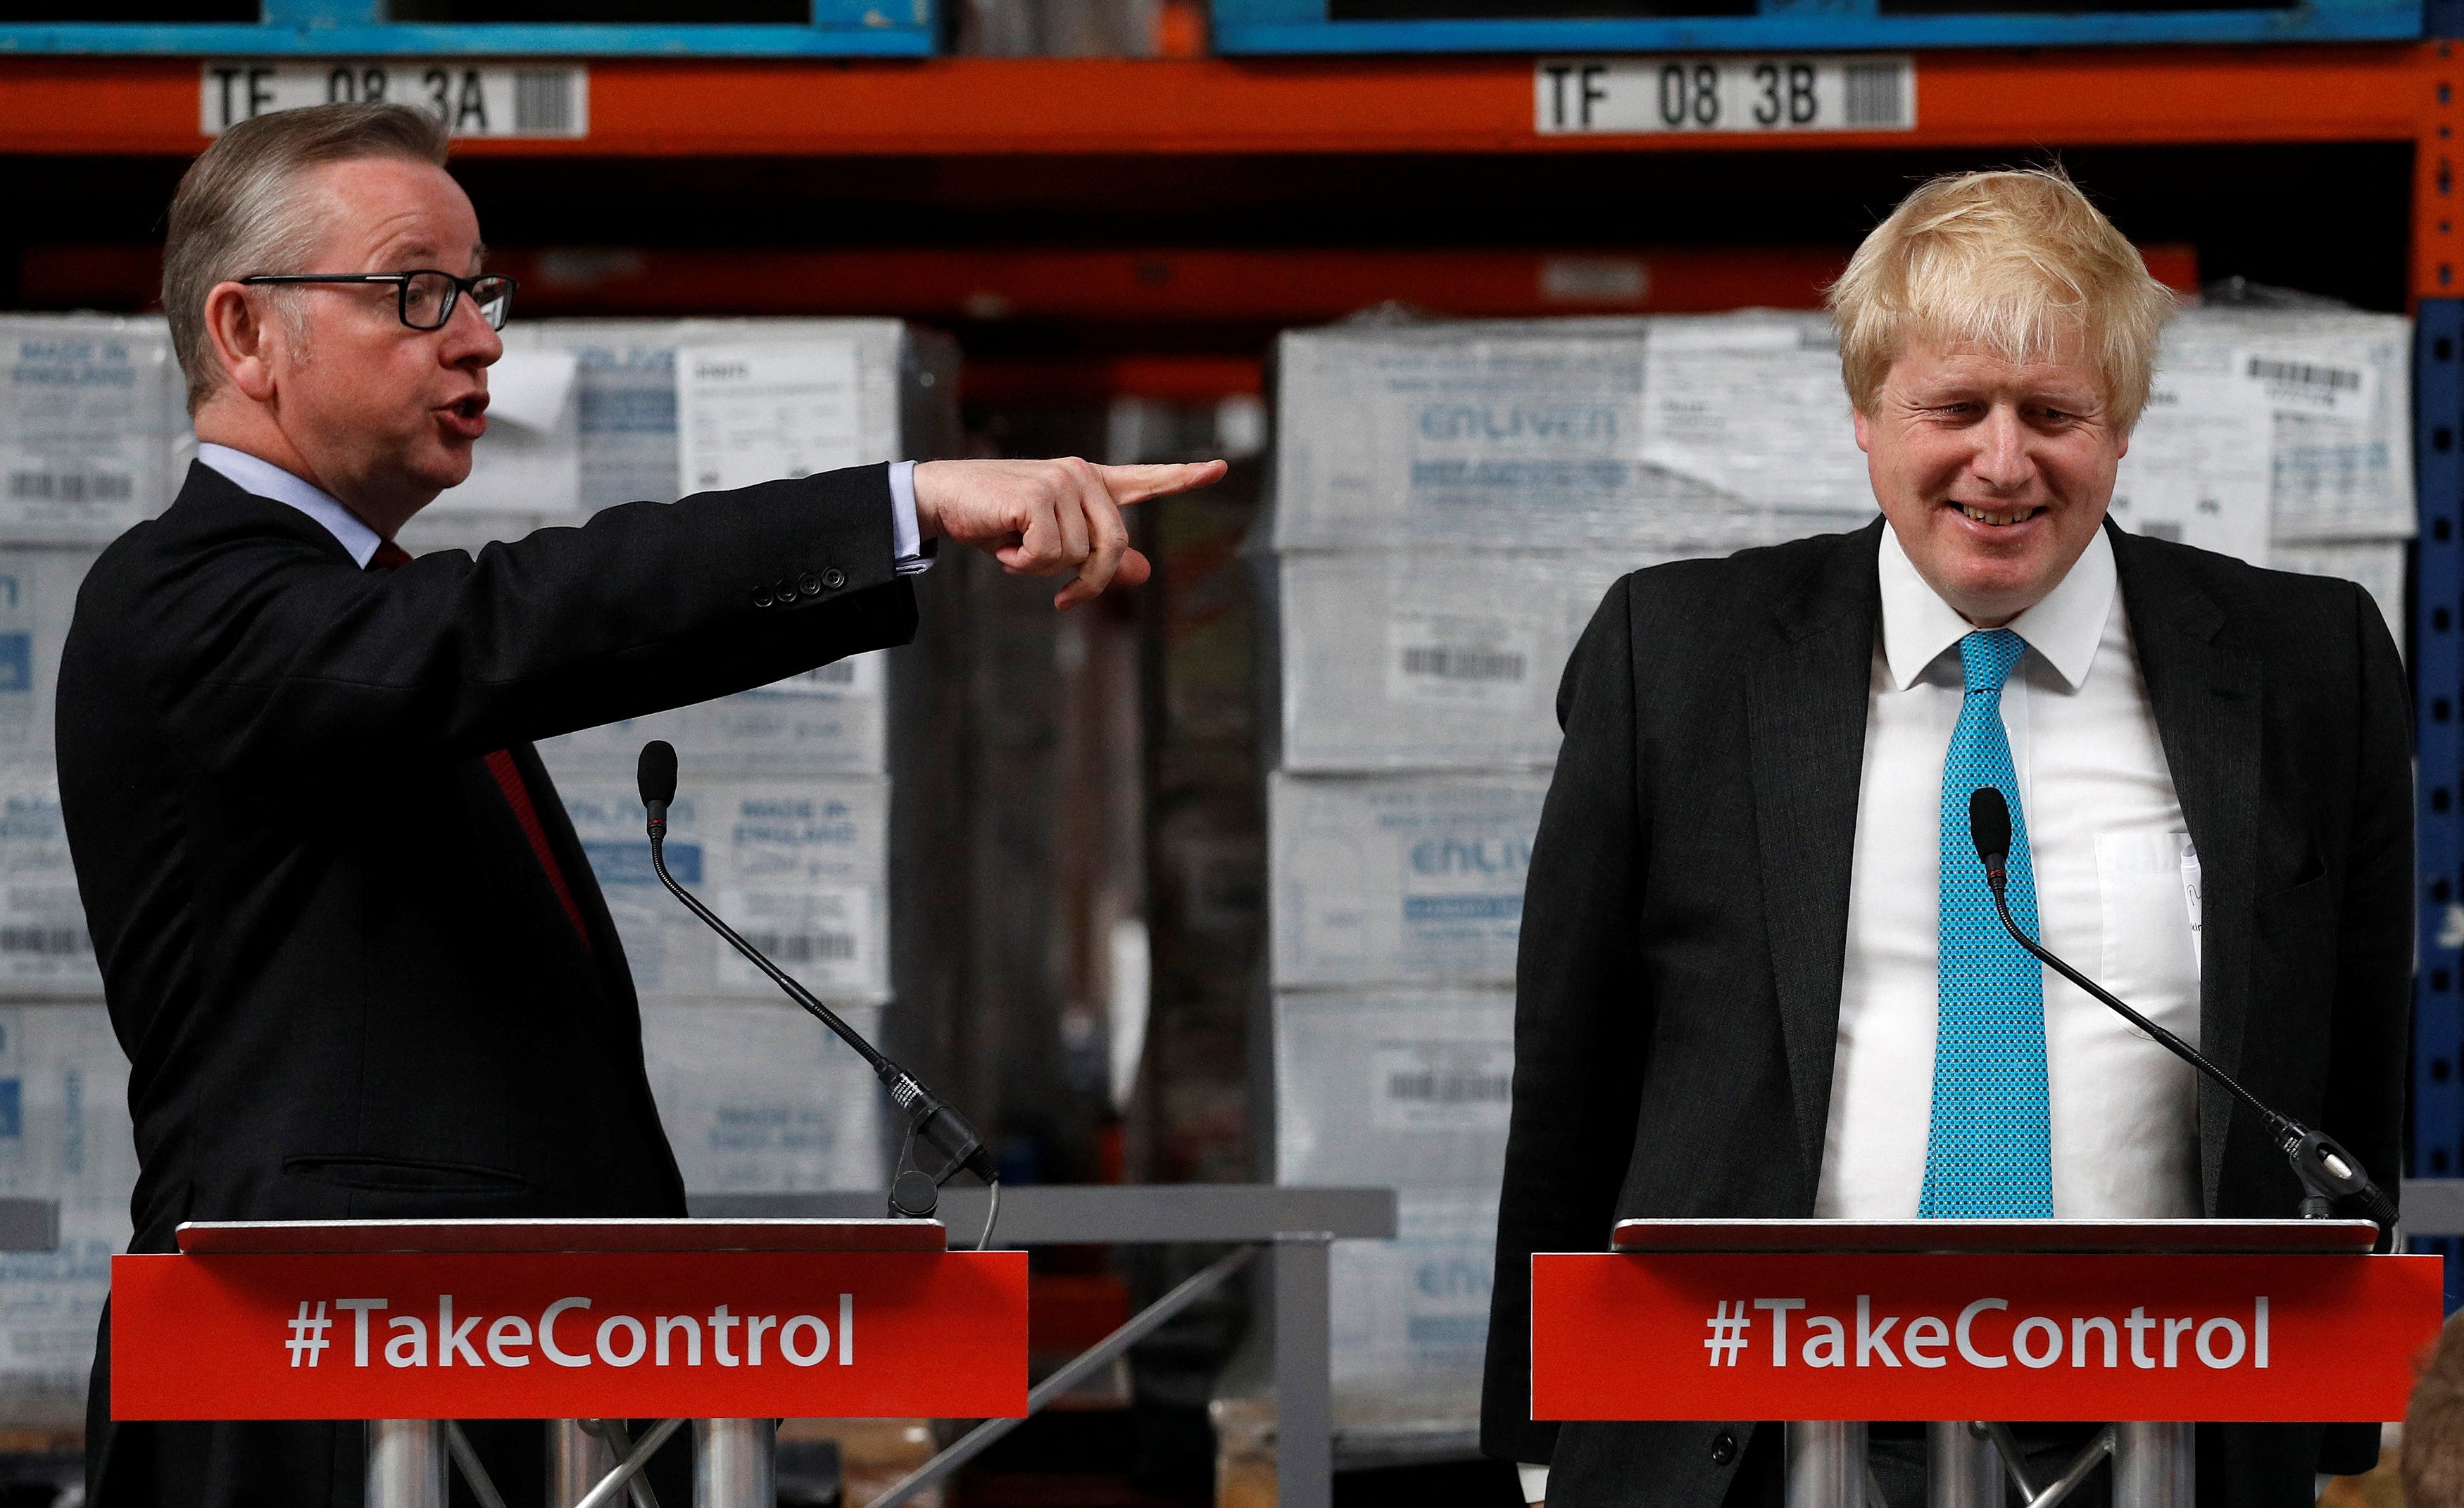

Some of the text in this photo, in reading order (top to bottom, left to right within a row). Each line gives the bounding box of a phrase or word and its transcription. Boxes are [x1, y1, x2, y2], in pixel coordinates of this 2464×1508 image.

[1543, 64, 1819, 127] TF 08 3B
[284, 1293, 853, 1368] #TakeControl
[1704, 1294, 2269, 1369] #TakeControl
